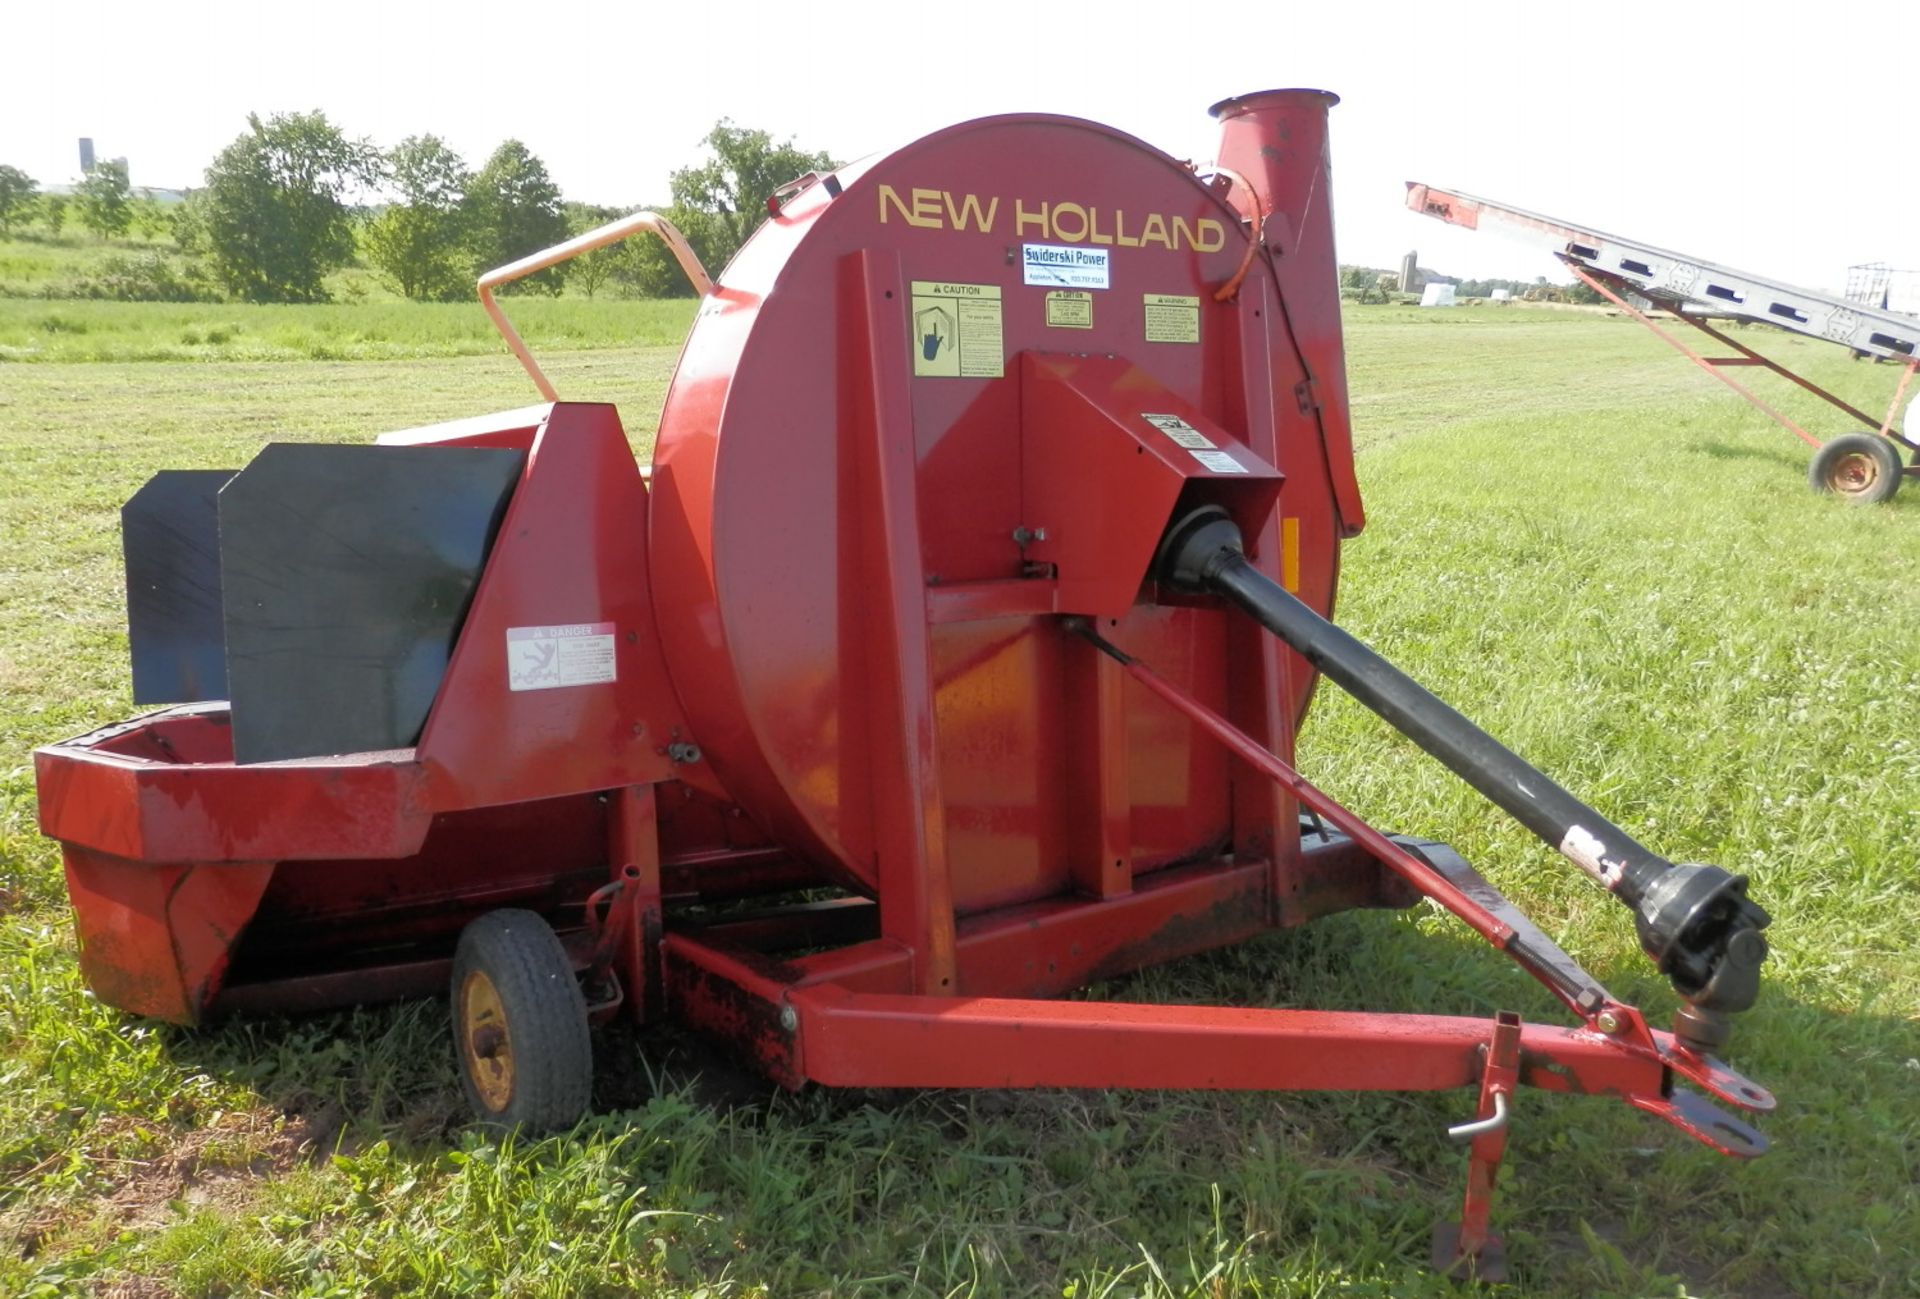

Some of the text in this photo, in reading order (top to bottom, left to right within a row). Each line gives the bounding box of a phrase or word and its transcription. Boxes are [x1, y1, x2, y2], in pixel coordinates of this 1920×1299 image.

[879, 184, 1225, 253] NEW HOLLAND
[1076, 250, 1106, 266] Power
[943, 285, 980, 295] CAUTION
[550, 626, 593, 637] DANGER
